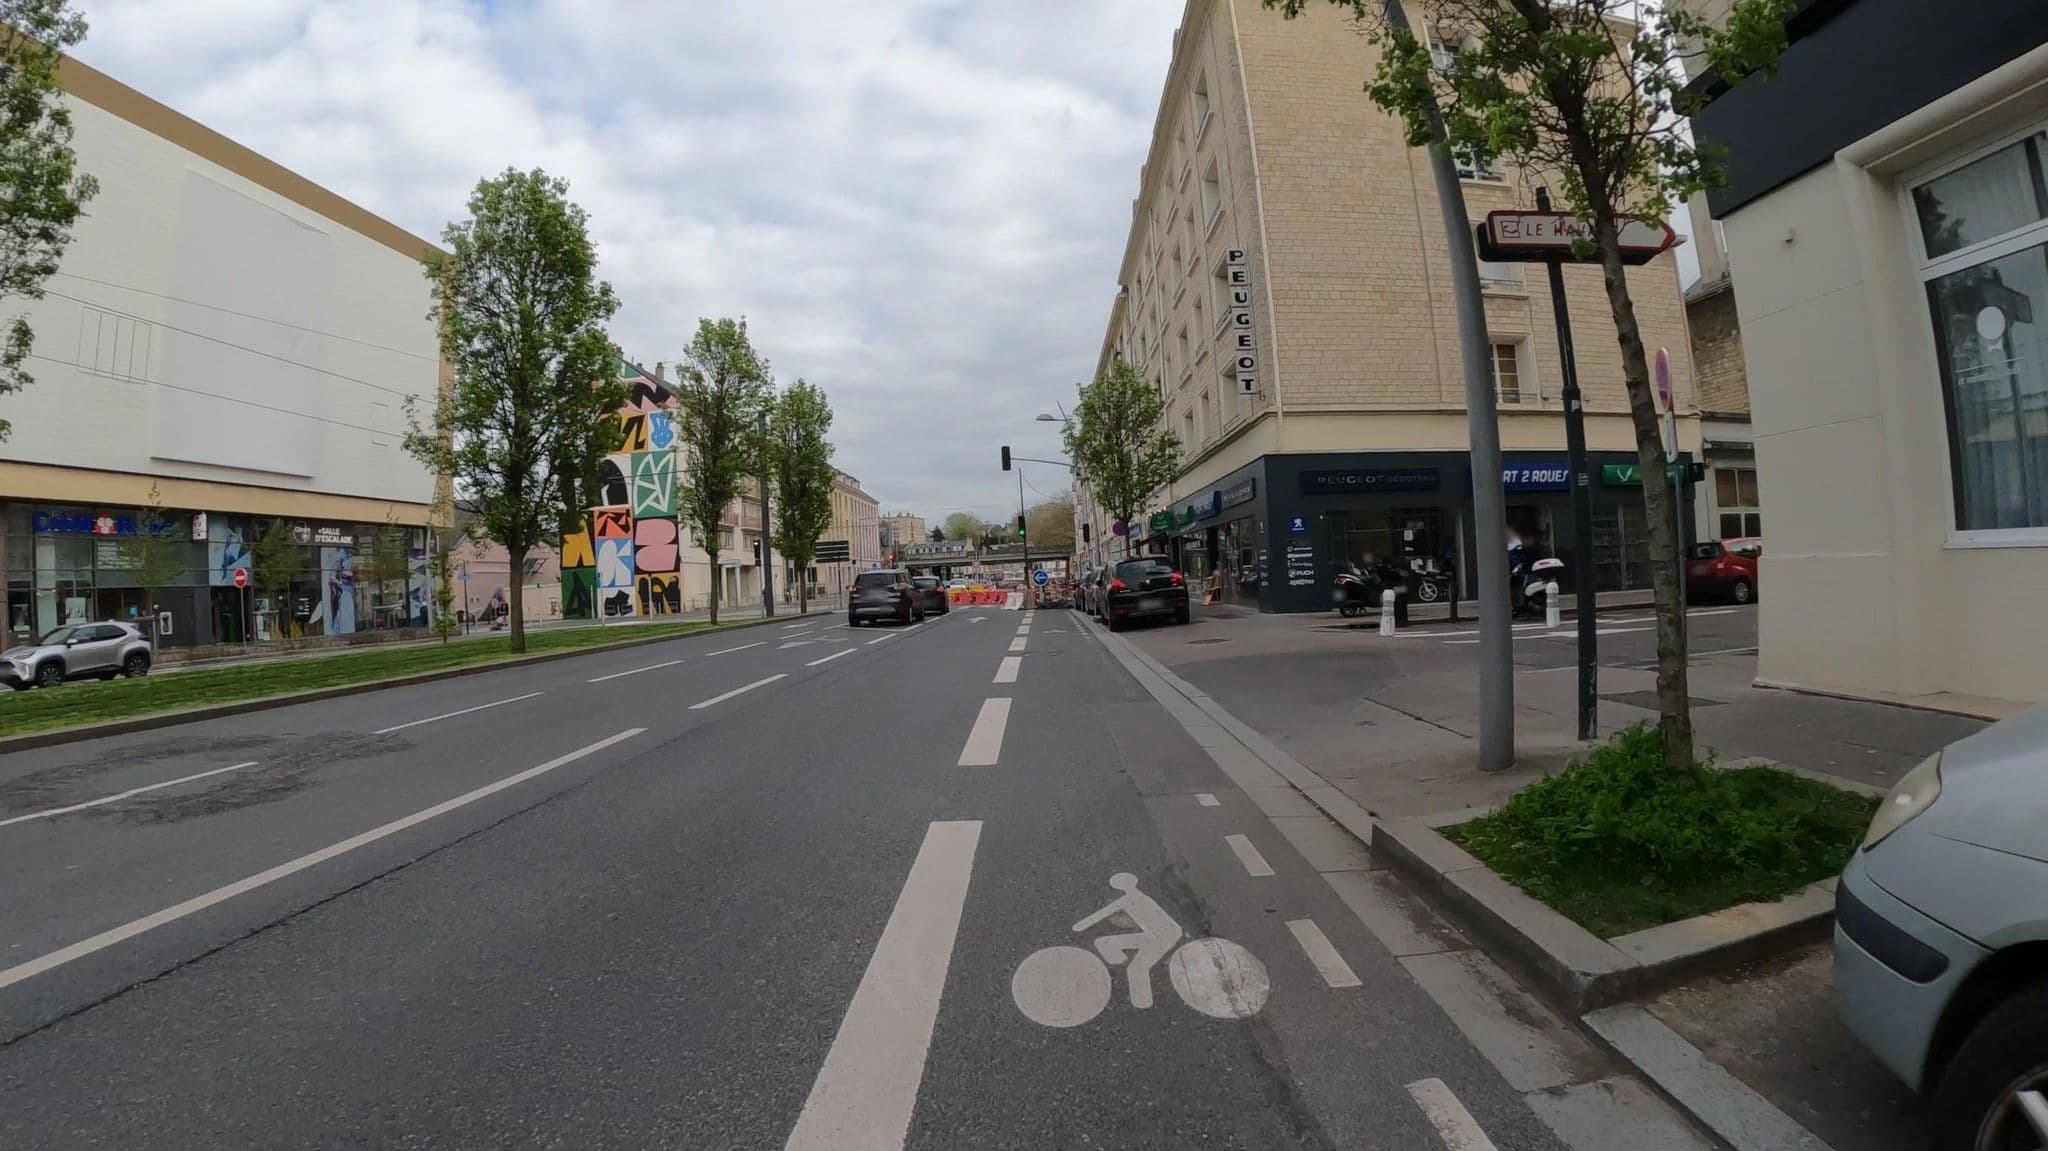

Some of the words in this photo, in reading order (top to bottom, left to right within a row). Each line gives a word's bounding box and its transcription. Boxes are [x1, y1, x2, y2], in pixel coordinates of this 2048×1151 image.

[1526, 223, 1543, 236] LE
[1228, 249, 1255, 392] PEUGEOT
[1318, 474, 1386, 484] PEUGEOT
[1521, 469, 1530, 482] 2
[1531, 469, 1569, 482] ROUES
